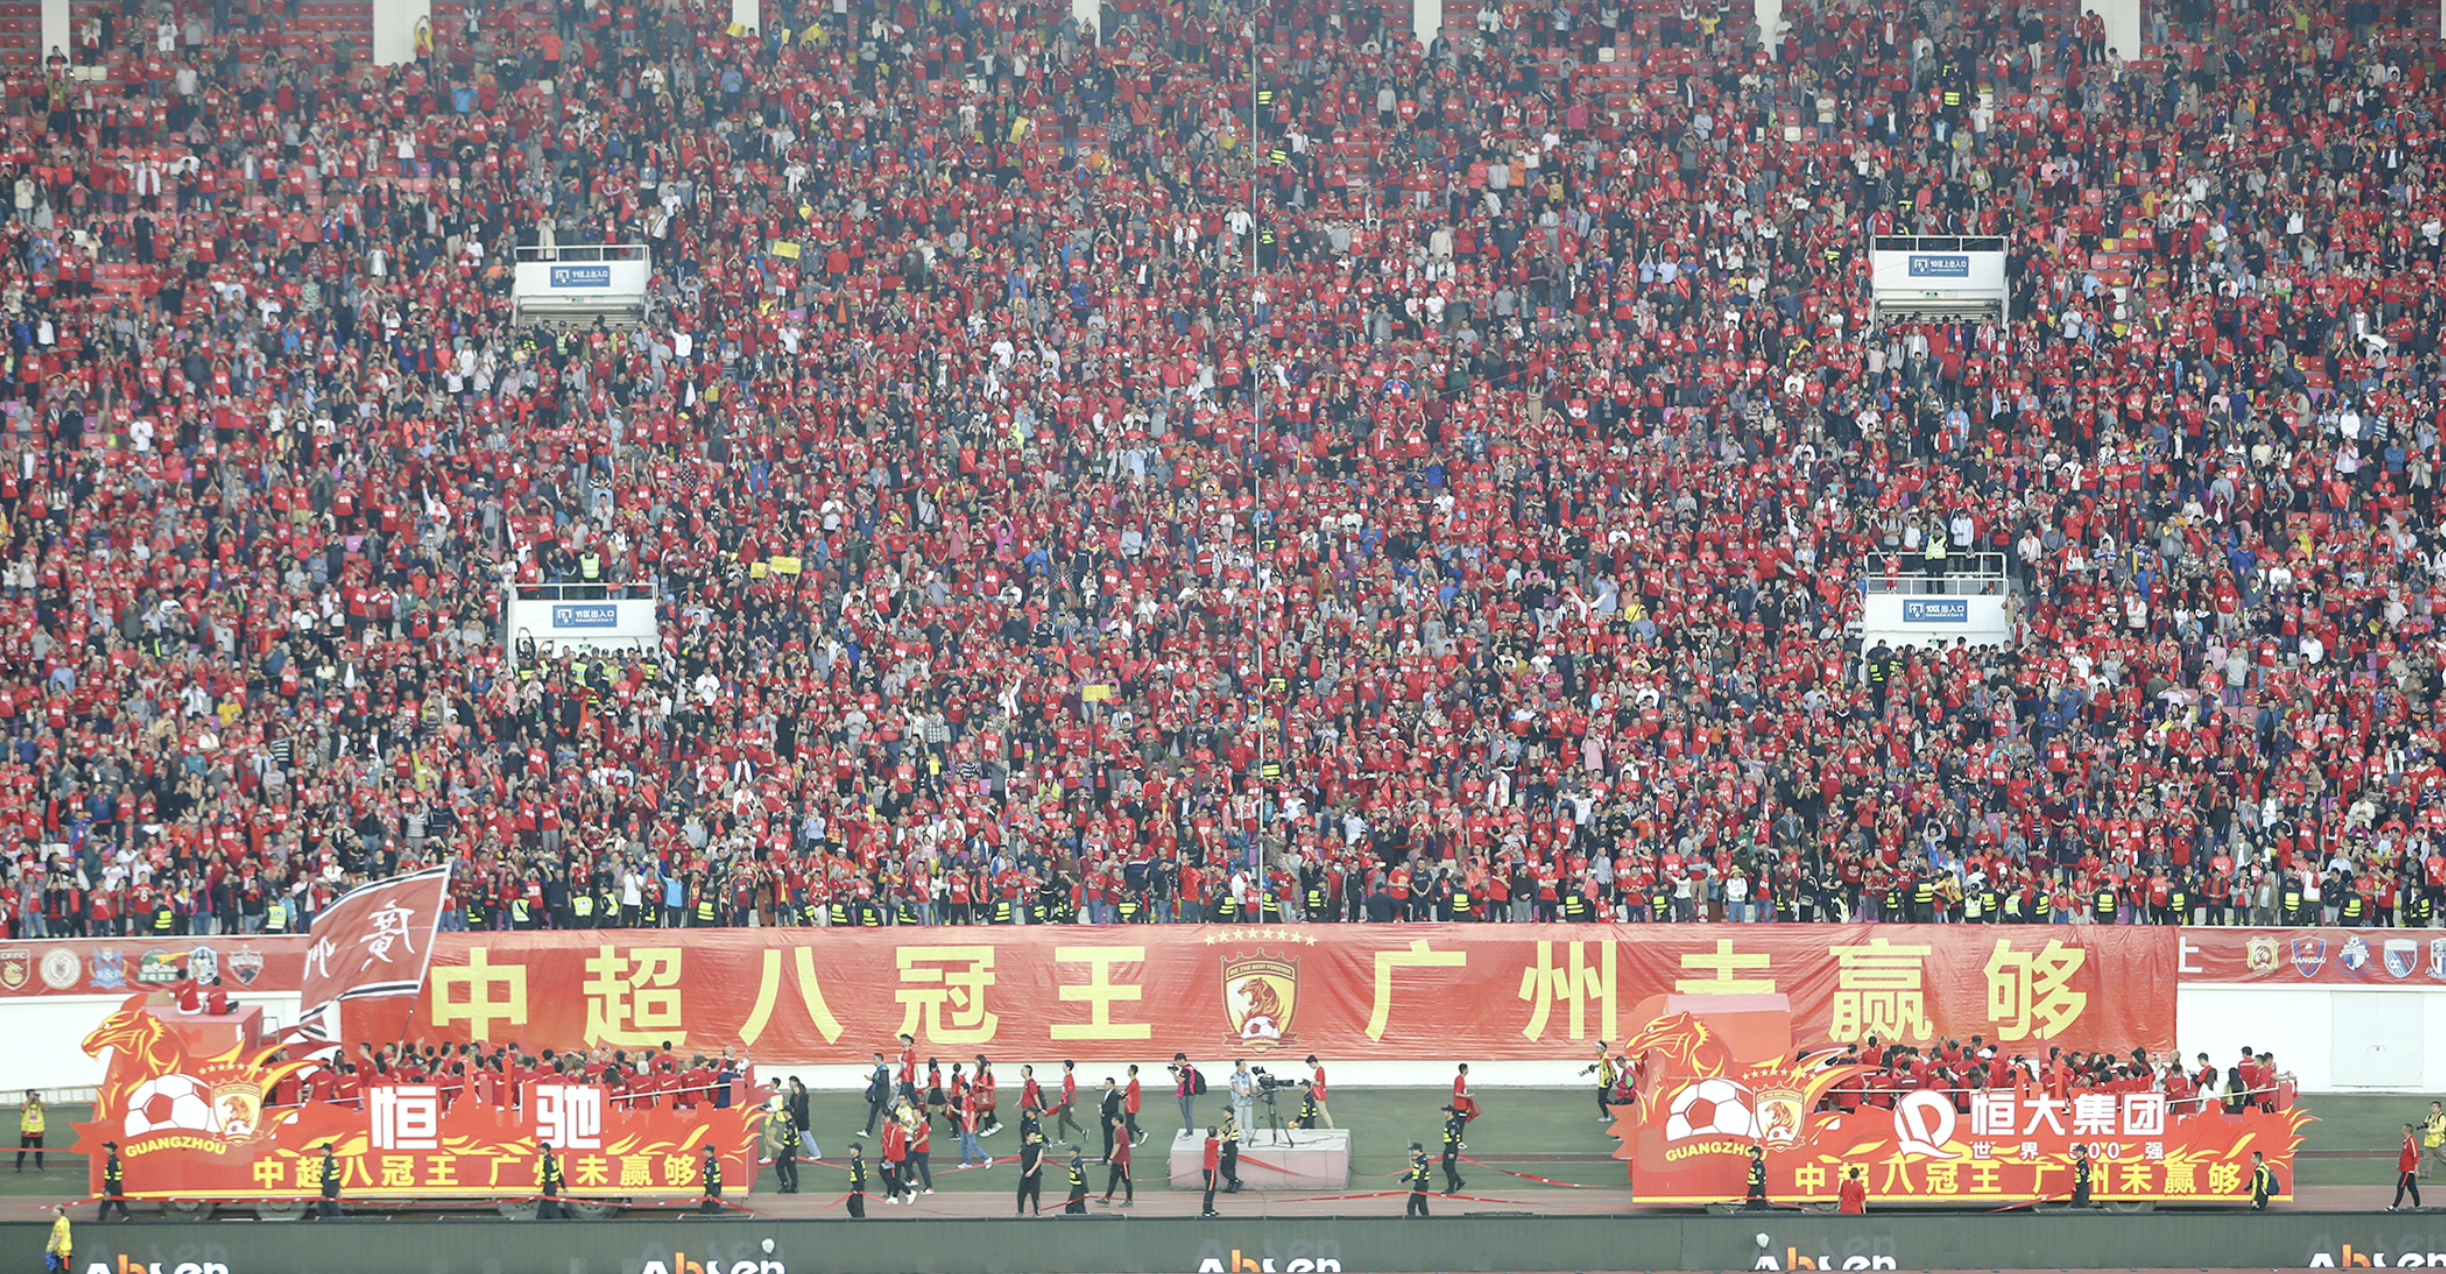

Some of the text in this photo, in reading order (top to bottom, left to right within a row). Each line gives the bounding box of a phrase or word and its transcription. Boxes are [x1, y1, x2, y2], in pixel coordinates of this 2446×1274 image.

[140, 891, 149, 902] 8
[431, 945, 1151, 1048] 中超八冠王
[370, 1086, 601, 1150] 恒驰
[1971, 1092, 2165, 1136] 恒大集团
[125, 1136, 227, 1157] GUANGZHOU
